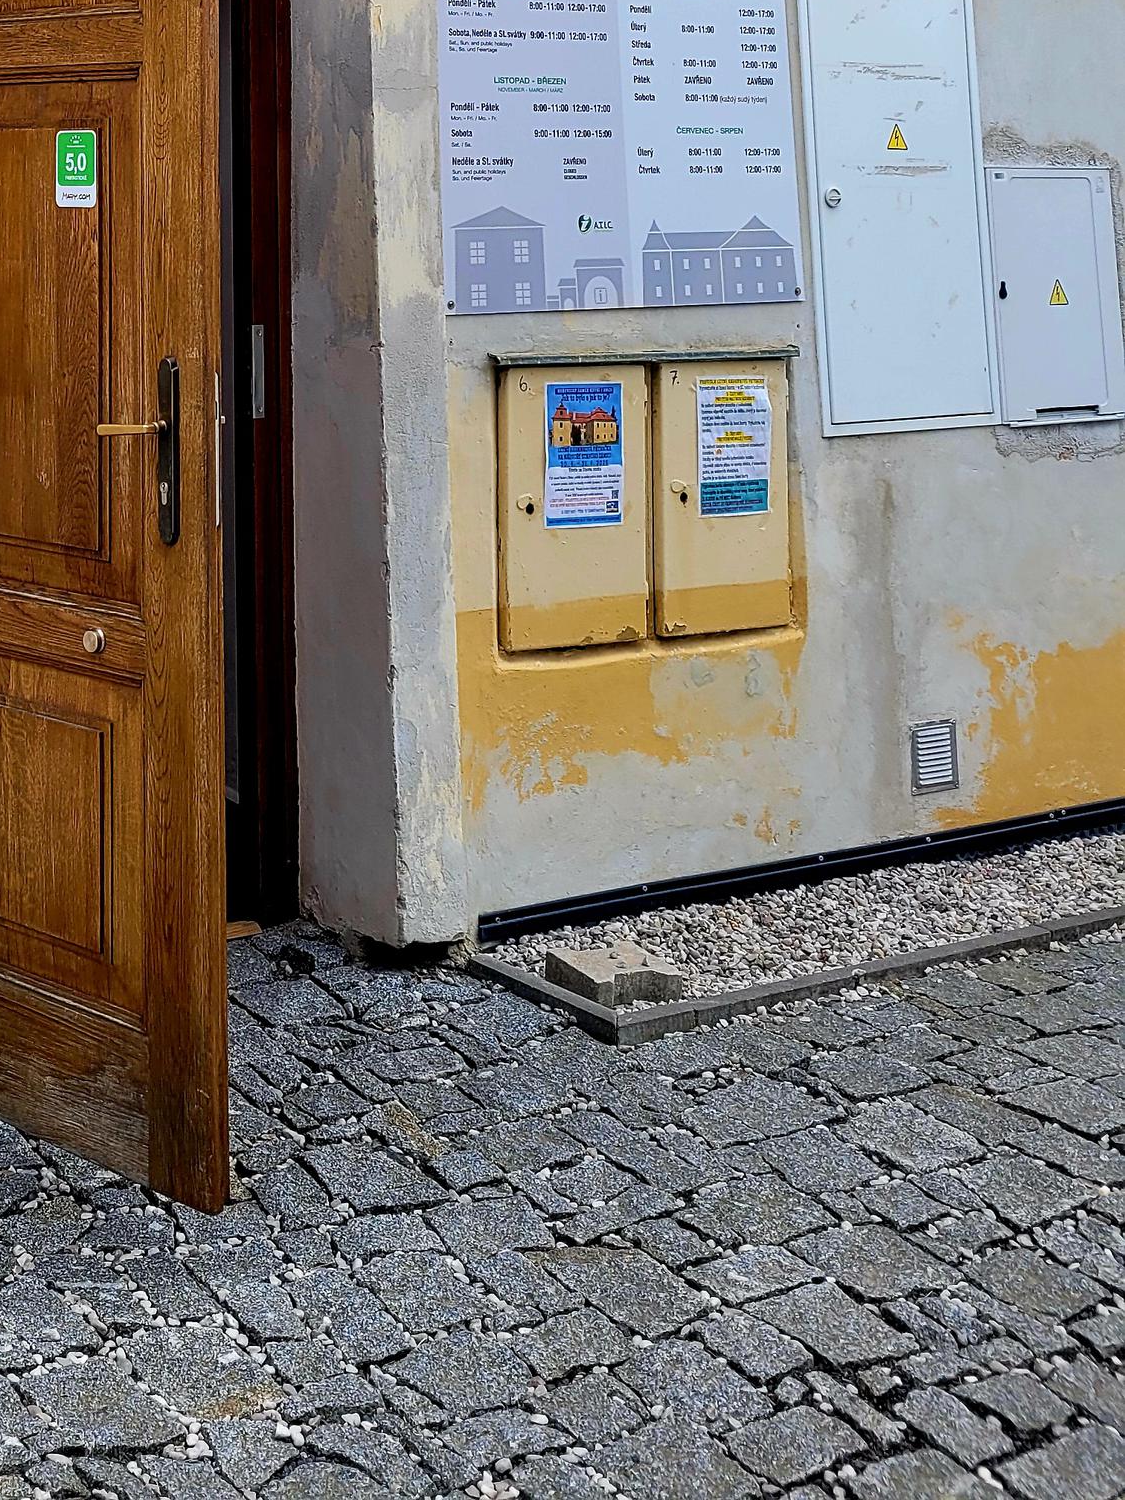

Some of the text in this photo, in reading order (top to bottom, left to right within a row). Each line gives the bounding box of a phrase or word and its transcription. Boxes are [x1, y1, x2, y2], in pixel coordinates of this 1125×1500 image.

[478, 0, 496, 8] Pátek
[529, 2, 564, 11] 8:00-11:00
[568, 3, 606, 12] 12:00-17:00
[630, 4, 774, 18] Pondělí 12:00-17:00
[448, 28, 472, 38] Sobota,
[472, 28, 492, 38] Neděle
[530, 31, 566, 40] 9:00-11:00
[569, 32, 608, 41] 12:00-17:00
[682, 25, 714, 34] 8:00-11:00
[740, 26, 776, 36] 12:00-17:00
[632, 40, 776, 52] Středa 12:00-17:00
[632, 56, 778, 69] Čtvrtek 8:00-11:00 12:00-17:00
[494, 76, 530, 84] LISTOPAD
[536, 76, 567, 85] BŘEZEN
[634, 74, 774, 86] Pátek ZAVŘENO ZAVŘENO
[634, 92, 656, 102] Sobota
[686, 94, 718, 102] 8:00-11:00
[738, 96, 750, 104] sudý
[450, 102, 475, 111] Pondělí
[481, 102, 500, 112] Pátek
[533, 104, 569, 112] 8:00-11:00
[572, 104, 610, 112] 12:00-17:00
[451, 129, 612, 138] Sobota 9:00-11:00 12:00-15:00
[676, 126, 714, 134] ČERVENEC
[688, 148, 722, 156] 8:00-11:00
[744, 148, 780, 156] 12:00-17:00
[66, 152, 87, 174] 5,0
[452, 156, 475, 166] Neděle
[492, 156, 514, 167] svátky
[562, 156, 587, 166] ZAVŘENO
[638, 164, 782, 174] Čtvrtek 8:00-11:00 12:00-17:00
[518, 375, 532, 392] 6.
[670, 370, 680, 386] 7.
